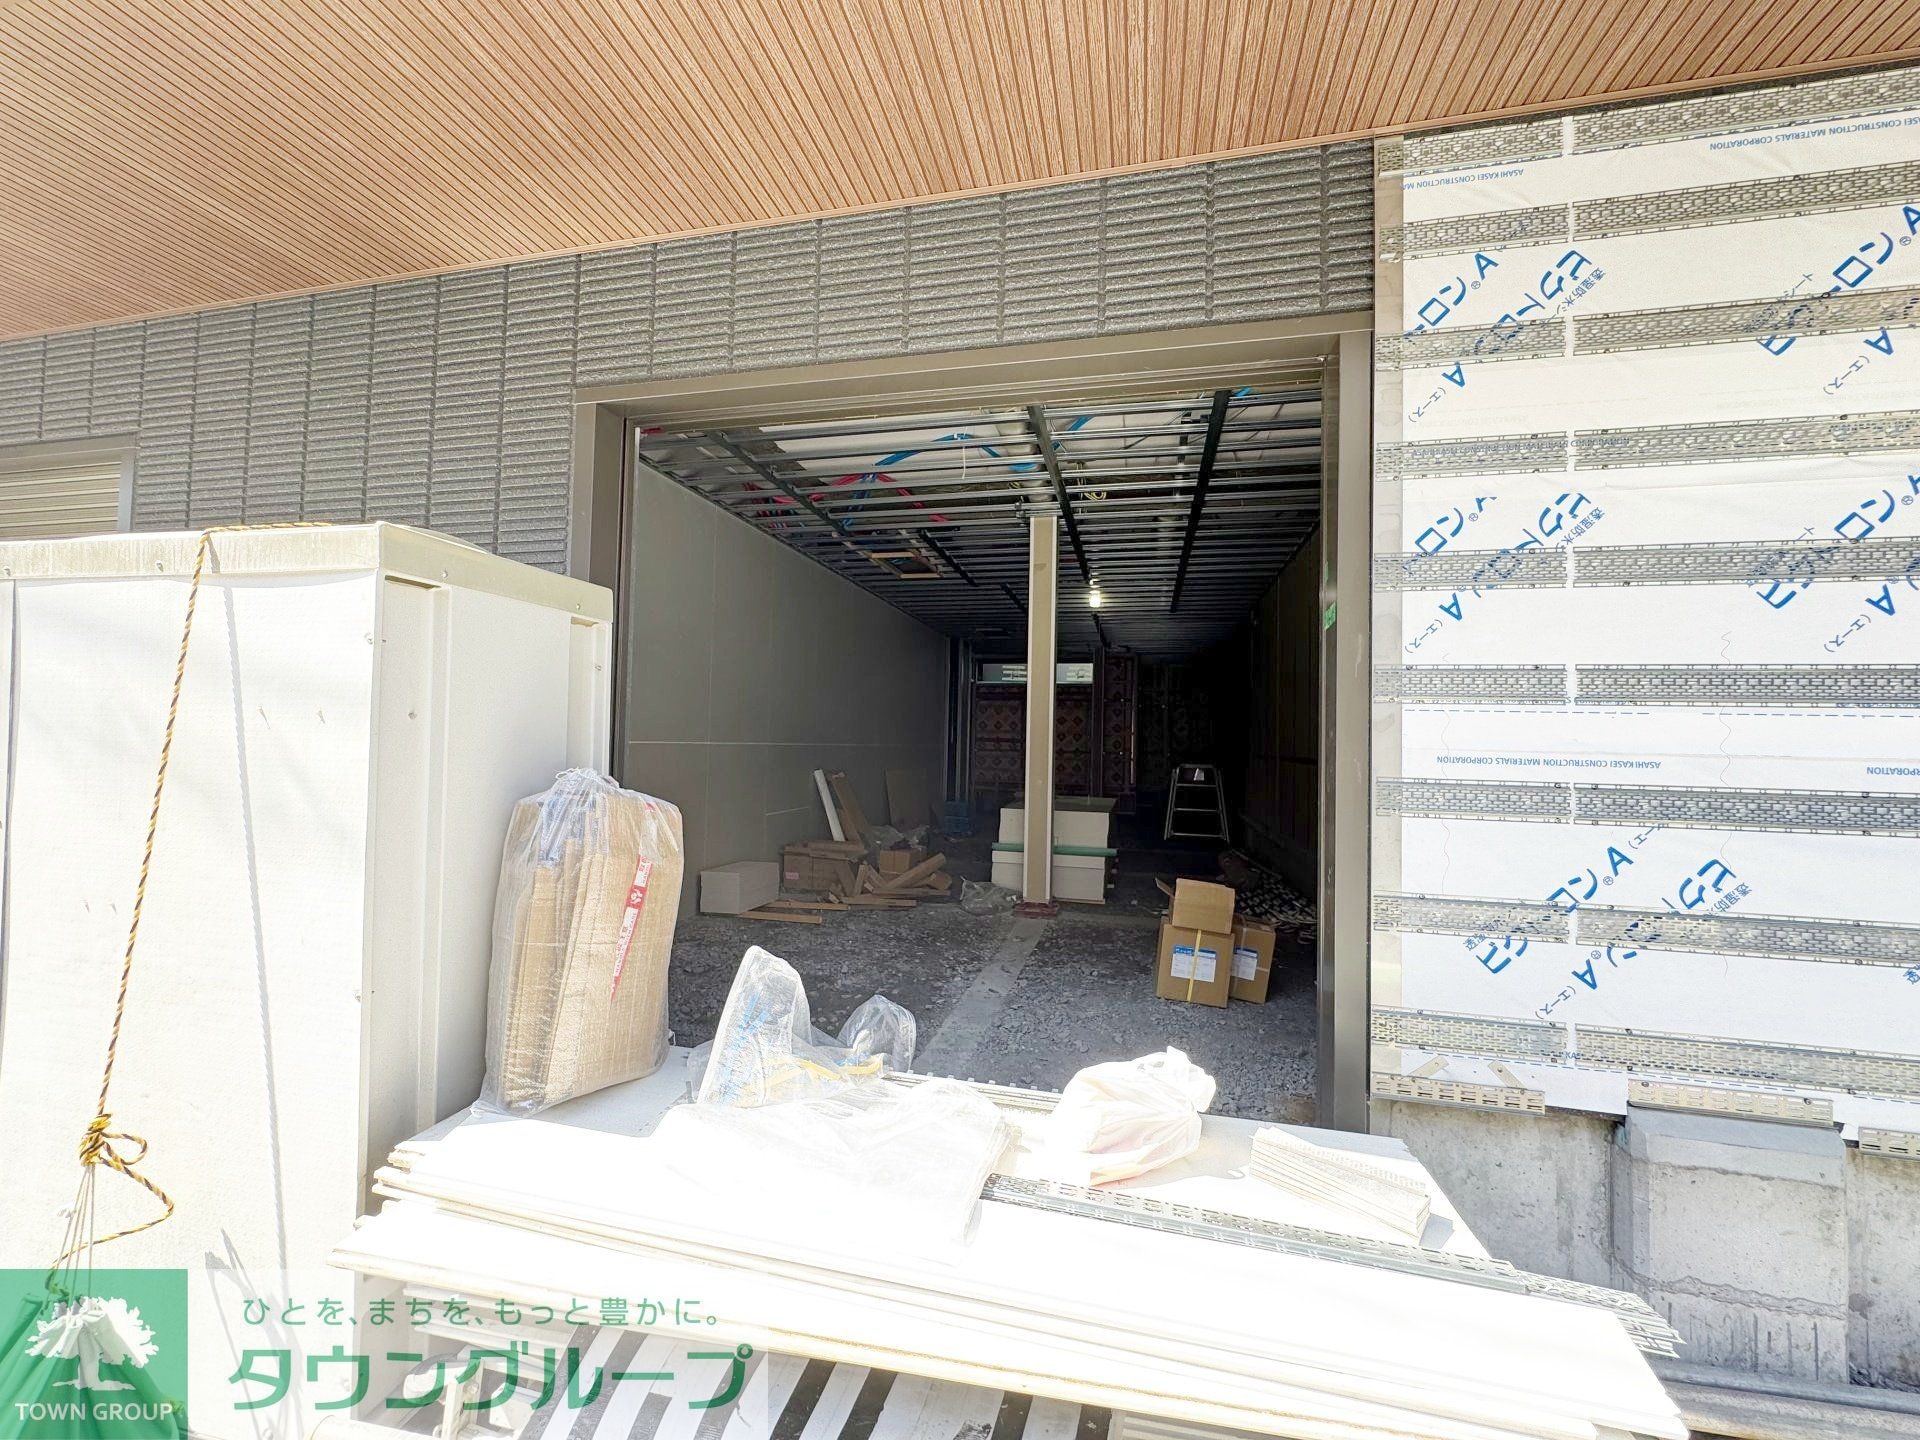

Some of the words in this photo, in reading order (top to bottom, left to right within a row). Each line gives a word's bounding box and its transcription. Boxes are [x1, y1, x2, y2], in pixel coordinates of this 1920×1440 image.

[1829, 120, 1901, 134] CONSTRUCTION
[1775, 129, 1827, 142] MATERIALS
[1710, 136, 1772, 151] CORPORATION
[1478, 171, 1499, 181] KASEI
[1501, 168, 1524, 178] ASAHI
[1416, 174, 1475, 188] CONSTRUCTION
[1436, 756, 1493, 765] CORPORATION
[1495, 757, 1540, 766] MATERIALS
[1543, 758, 1608, 768] CONSTRUCTION
[1610, 760, 1635, 769] KASEI
[1636, 760, 1661, 769] ASAHI
